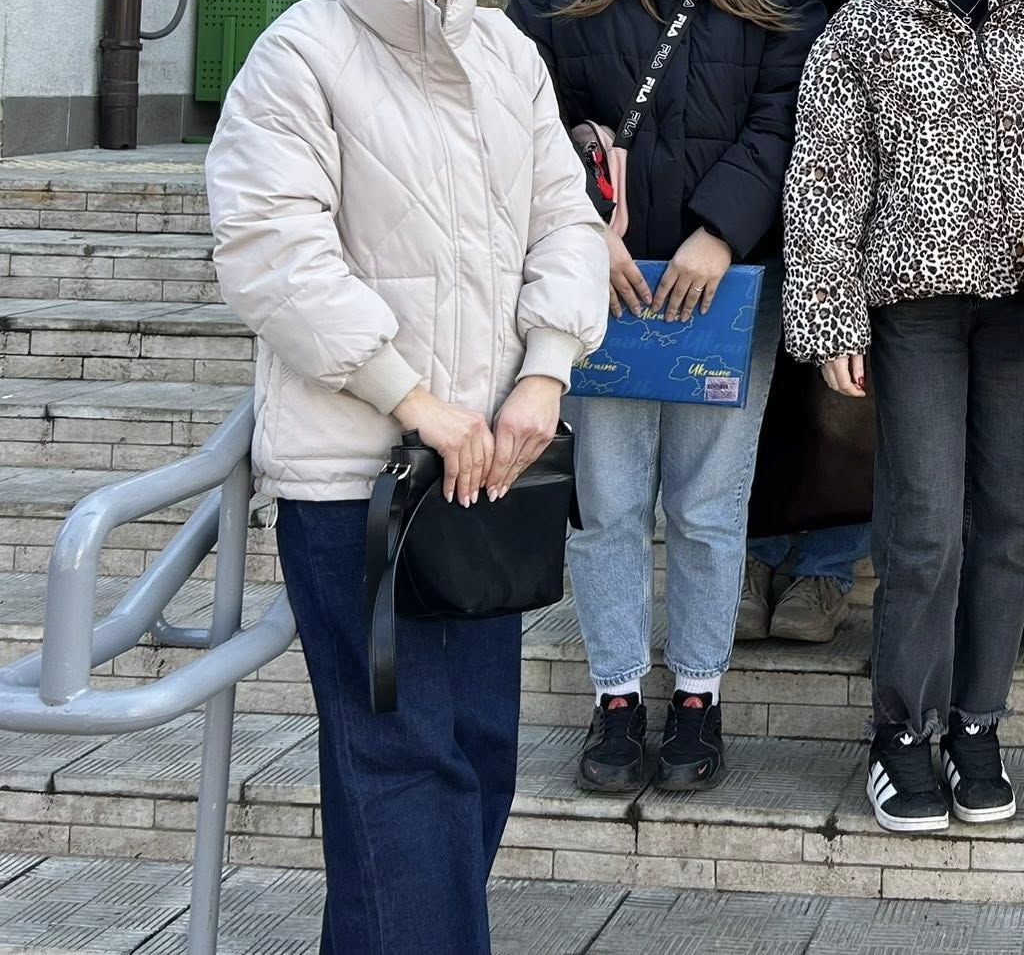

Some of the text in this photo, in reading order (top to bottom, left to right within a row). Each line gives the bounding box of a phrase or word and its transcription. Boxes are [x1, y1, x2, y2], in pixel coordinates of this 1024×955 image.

[667, 13, 687, 37] FILA
[651, 43, 671, 69] FILA
[635, 76, 656, 103] FILA
[622, 110, 642, 138] FILA
[688, 363, 732, 377] Ukraine
